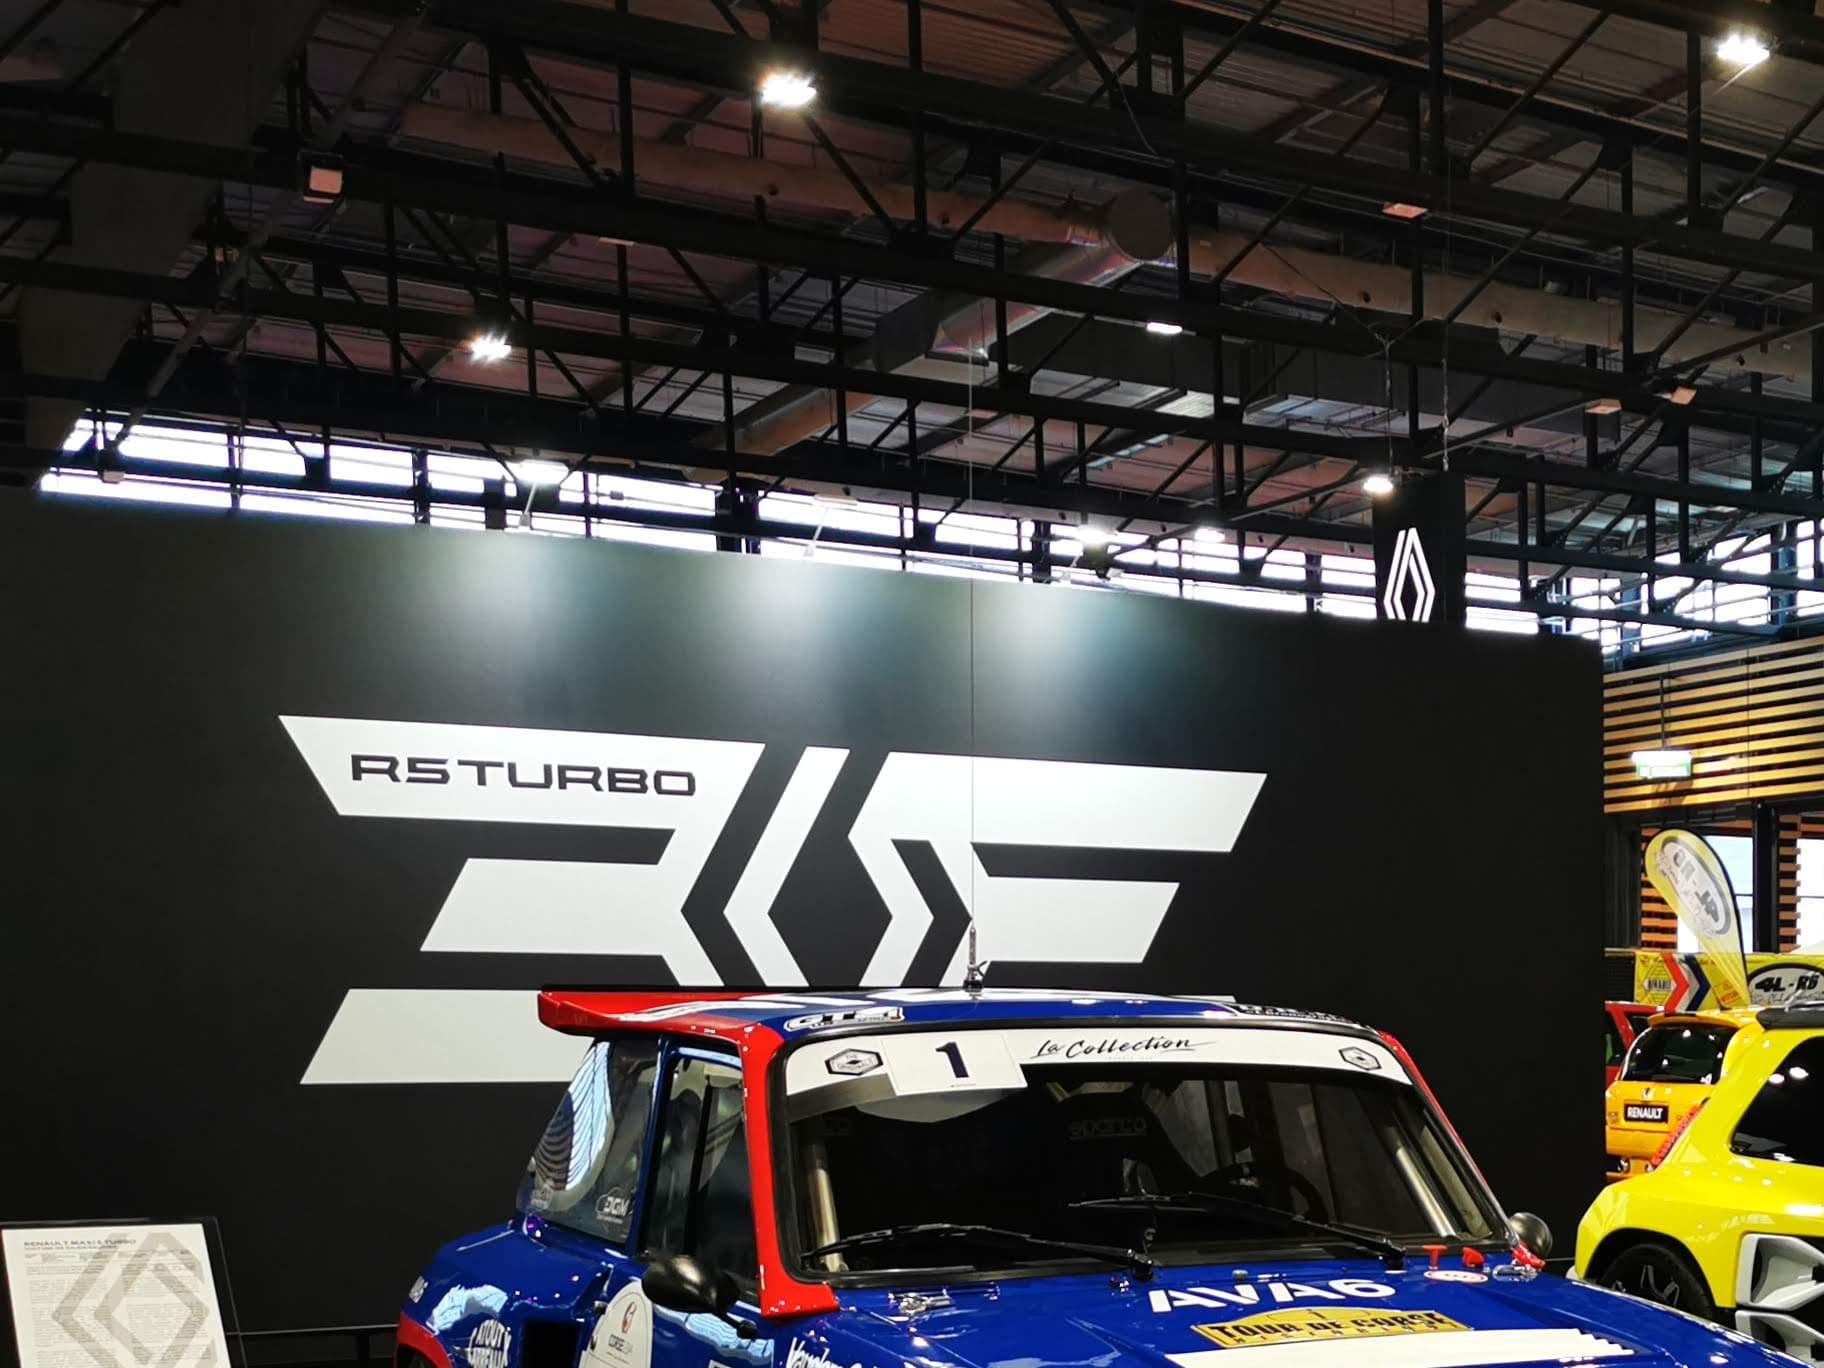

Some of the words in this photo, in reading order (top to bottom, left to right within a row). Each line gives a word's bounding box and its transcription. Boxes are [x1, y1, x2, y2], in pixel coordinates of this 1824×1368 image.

[935, 1041, 970, 1079] 1
[1031, 1040, 1066, 1060] La
[1066, 1036, 1196, 1058] Collection
[1626, 1106, 1664, 1120] RENAULT
[1147, 1278, 1396, 1313] AVA6
[1207, 1322, 1299, 1340] TOUR
[1309, 1319, 1345, 1333] DE
[1357, 1312, 1453, 1330] CORSE
